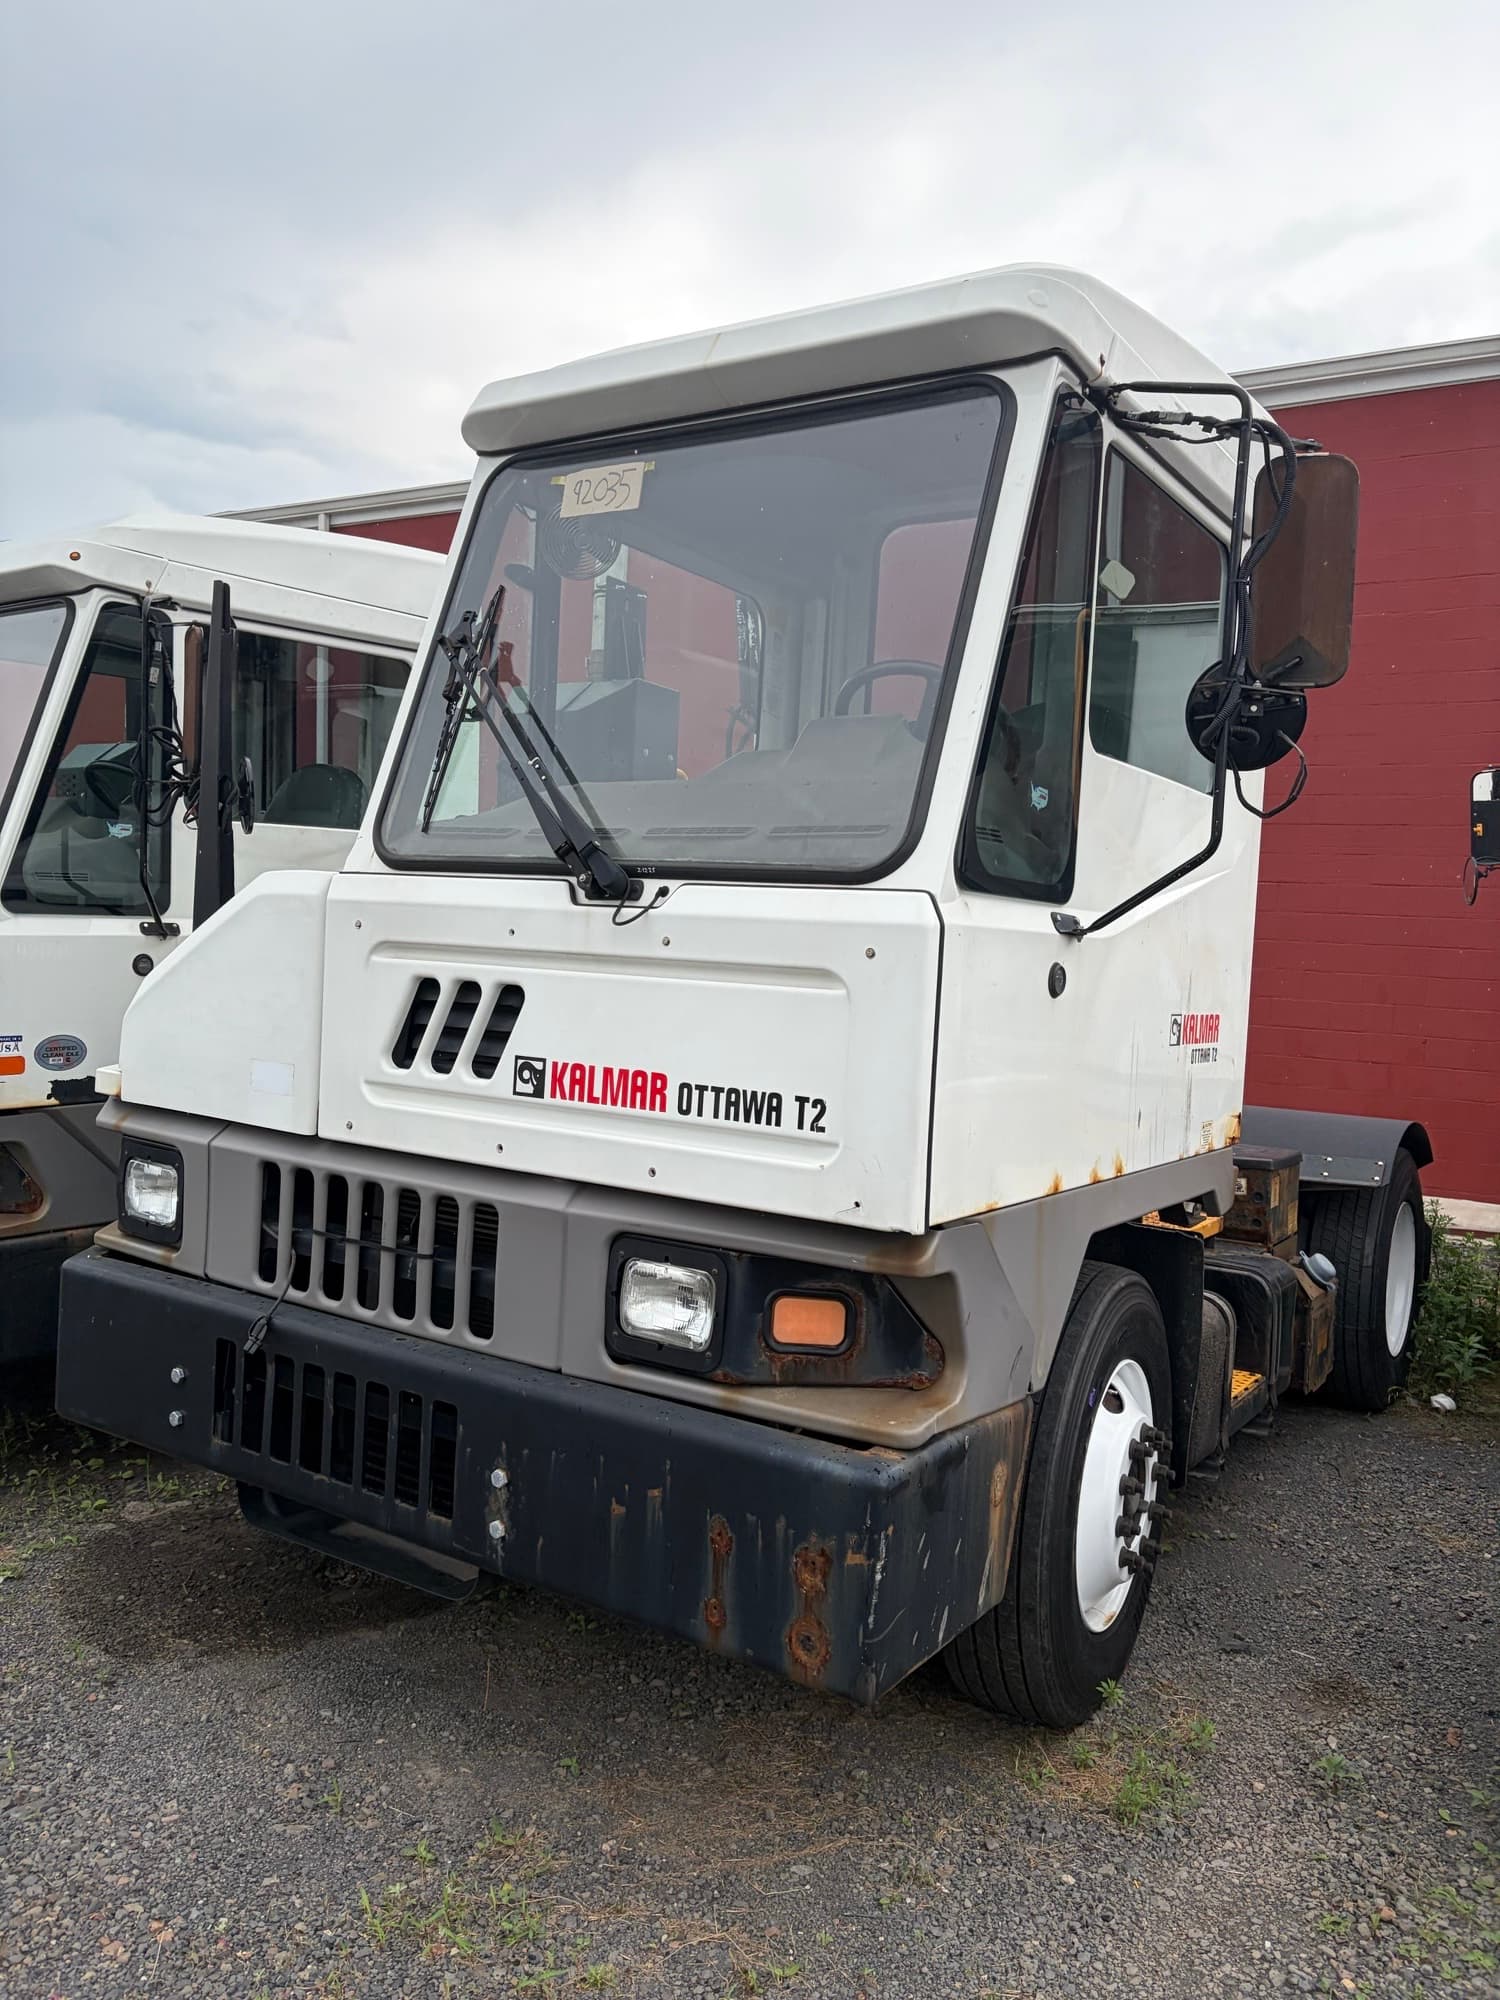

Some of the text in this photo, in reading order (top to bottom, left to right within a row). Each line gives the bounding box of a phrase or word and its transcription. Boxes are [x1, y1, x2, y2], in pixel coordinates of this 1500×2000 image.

[573, 467, 637, 509] 92035
[1182, 1014, 1220, 1045] KALMAR
[1190, 1047, 1218, 1064] OTTAWA T2
[550, 1061, 827, 1133] KALMAR OTTAWA T2
